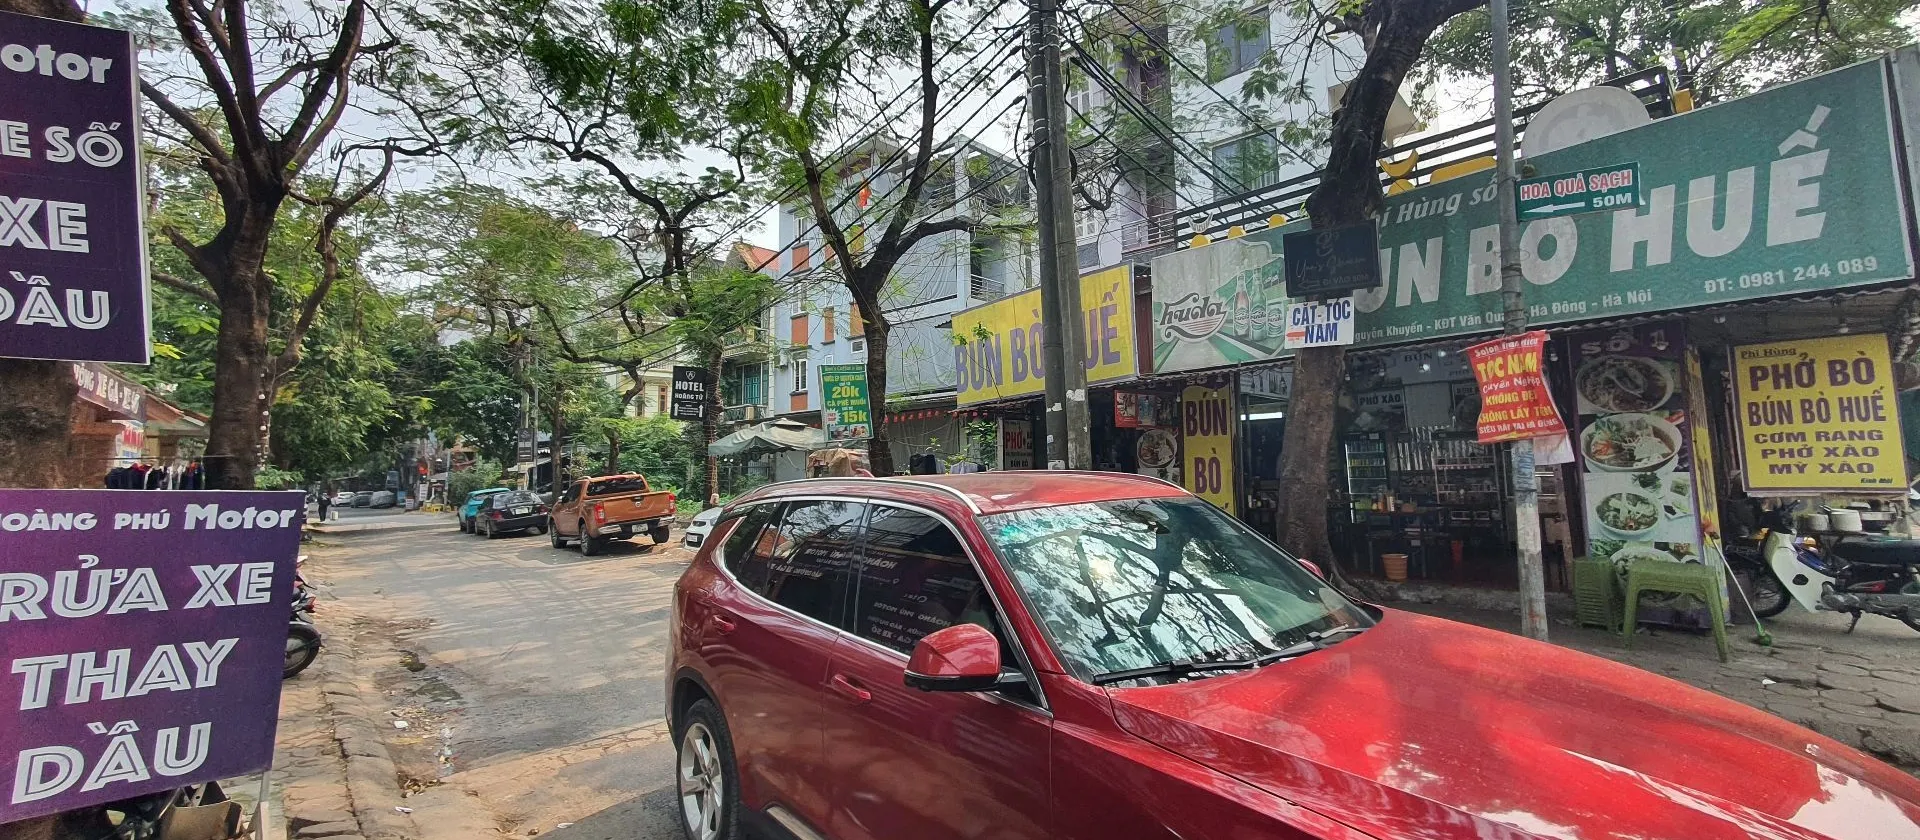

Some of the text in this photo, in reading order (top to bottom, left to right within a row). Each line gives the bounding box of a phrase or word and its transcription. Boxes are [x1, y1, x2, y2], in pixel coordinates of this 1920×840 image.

[0, 44, 112, 84] otor
[0, 120, 124, 168] E SỐ
[1520, 169, 1633, 201] HOA QUẢ SẠCH
[1593, 193, 1632, 208] 50M
[1610, 104, 1832, 274] HUẾ
[1396, 192, 1463, 224] Hùng
[1704, 256, 1878, 294] ĐT: 0981 244 089
[1160, 293, 1227, 326] huda
[1434, 317, 1456, 330] KĐT
[1459, 314, 1482, 327] Văn
[1552, 300, 1587, 315] Đông
[1627, 288, 1652, 305] Nội
[1010, 308, 1045, 383] BÒ
[1082, 282, 1121, 371] UẾ
[1304, 322, 1338, 344] NAM
[675, 380, 705, 392] HOTEL
[1476, 356, 1505, 383] TÓC
[1749, 350, 1876, 392] PHỞ BÒ
[831, 385, 860, 399] 20k
[1485, 390, 1519, 406] KHÔNG
[1747, 385, 1887, 427] BÚN BÒ HUẾ
[842, 410, 868, 423] 15k
[1185, 391, 1228, 437] BÚN
[1754, 429, 1884, 444] CƠM RANG
[1761, 444, 1880, 459] PHỞ XÀO
[1194, 447, 1222, 495] BÒ
[1819, 460, 1875, 474] XÀO
[0, 503, 297, 532] OÀNG PHÚ Motor
[0, 554, 275, 623] RỬA XE
[11, 637, 240, 711] THAY
[11, 719, 212, 805] DẦU
